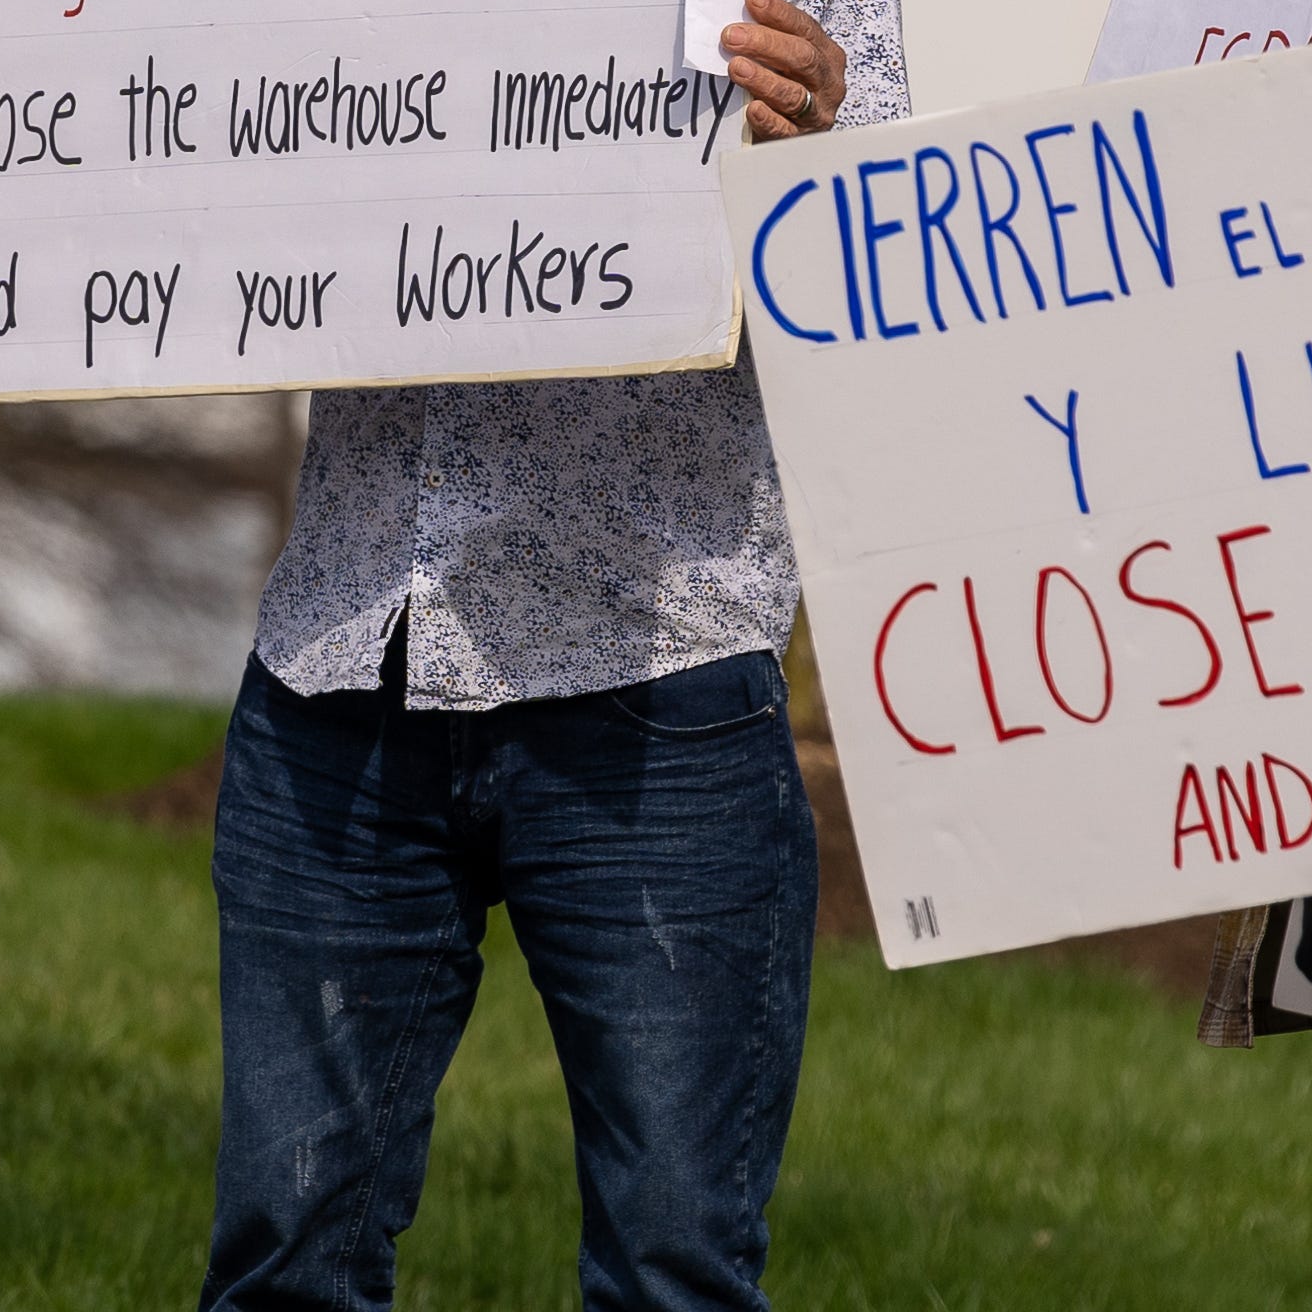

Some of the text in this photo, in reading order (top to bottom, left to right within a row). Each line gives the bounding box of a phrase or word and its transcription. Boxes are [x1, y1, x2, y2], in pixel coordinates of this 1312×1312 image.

[120, 55, 197, 161] the
[230, 56, 446, 157] warehouse
[84, 264, 180, 368] pay
[237, 271, 337, 356] your
[397, 220, 633, 327] Workers
[752, 101, 1175, 344] CIERREN
[1219, 201, 1305, 279] EL
[1024, 389, 1090, 514] Y
[874, 525, 1304, 756] CLOSE
